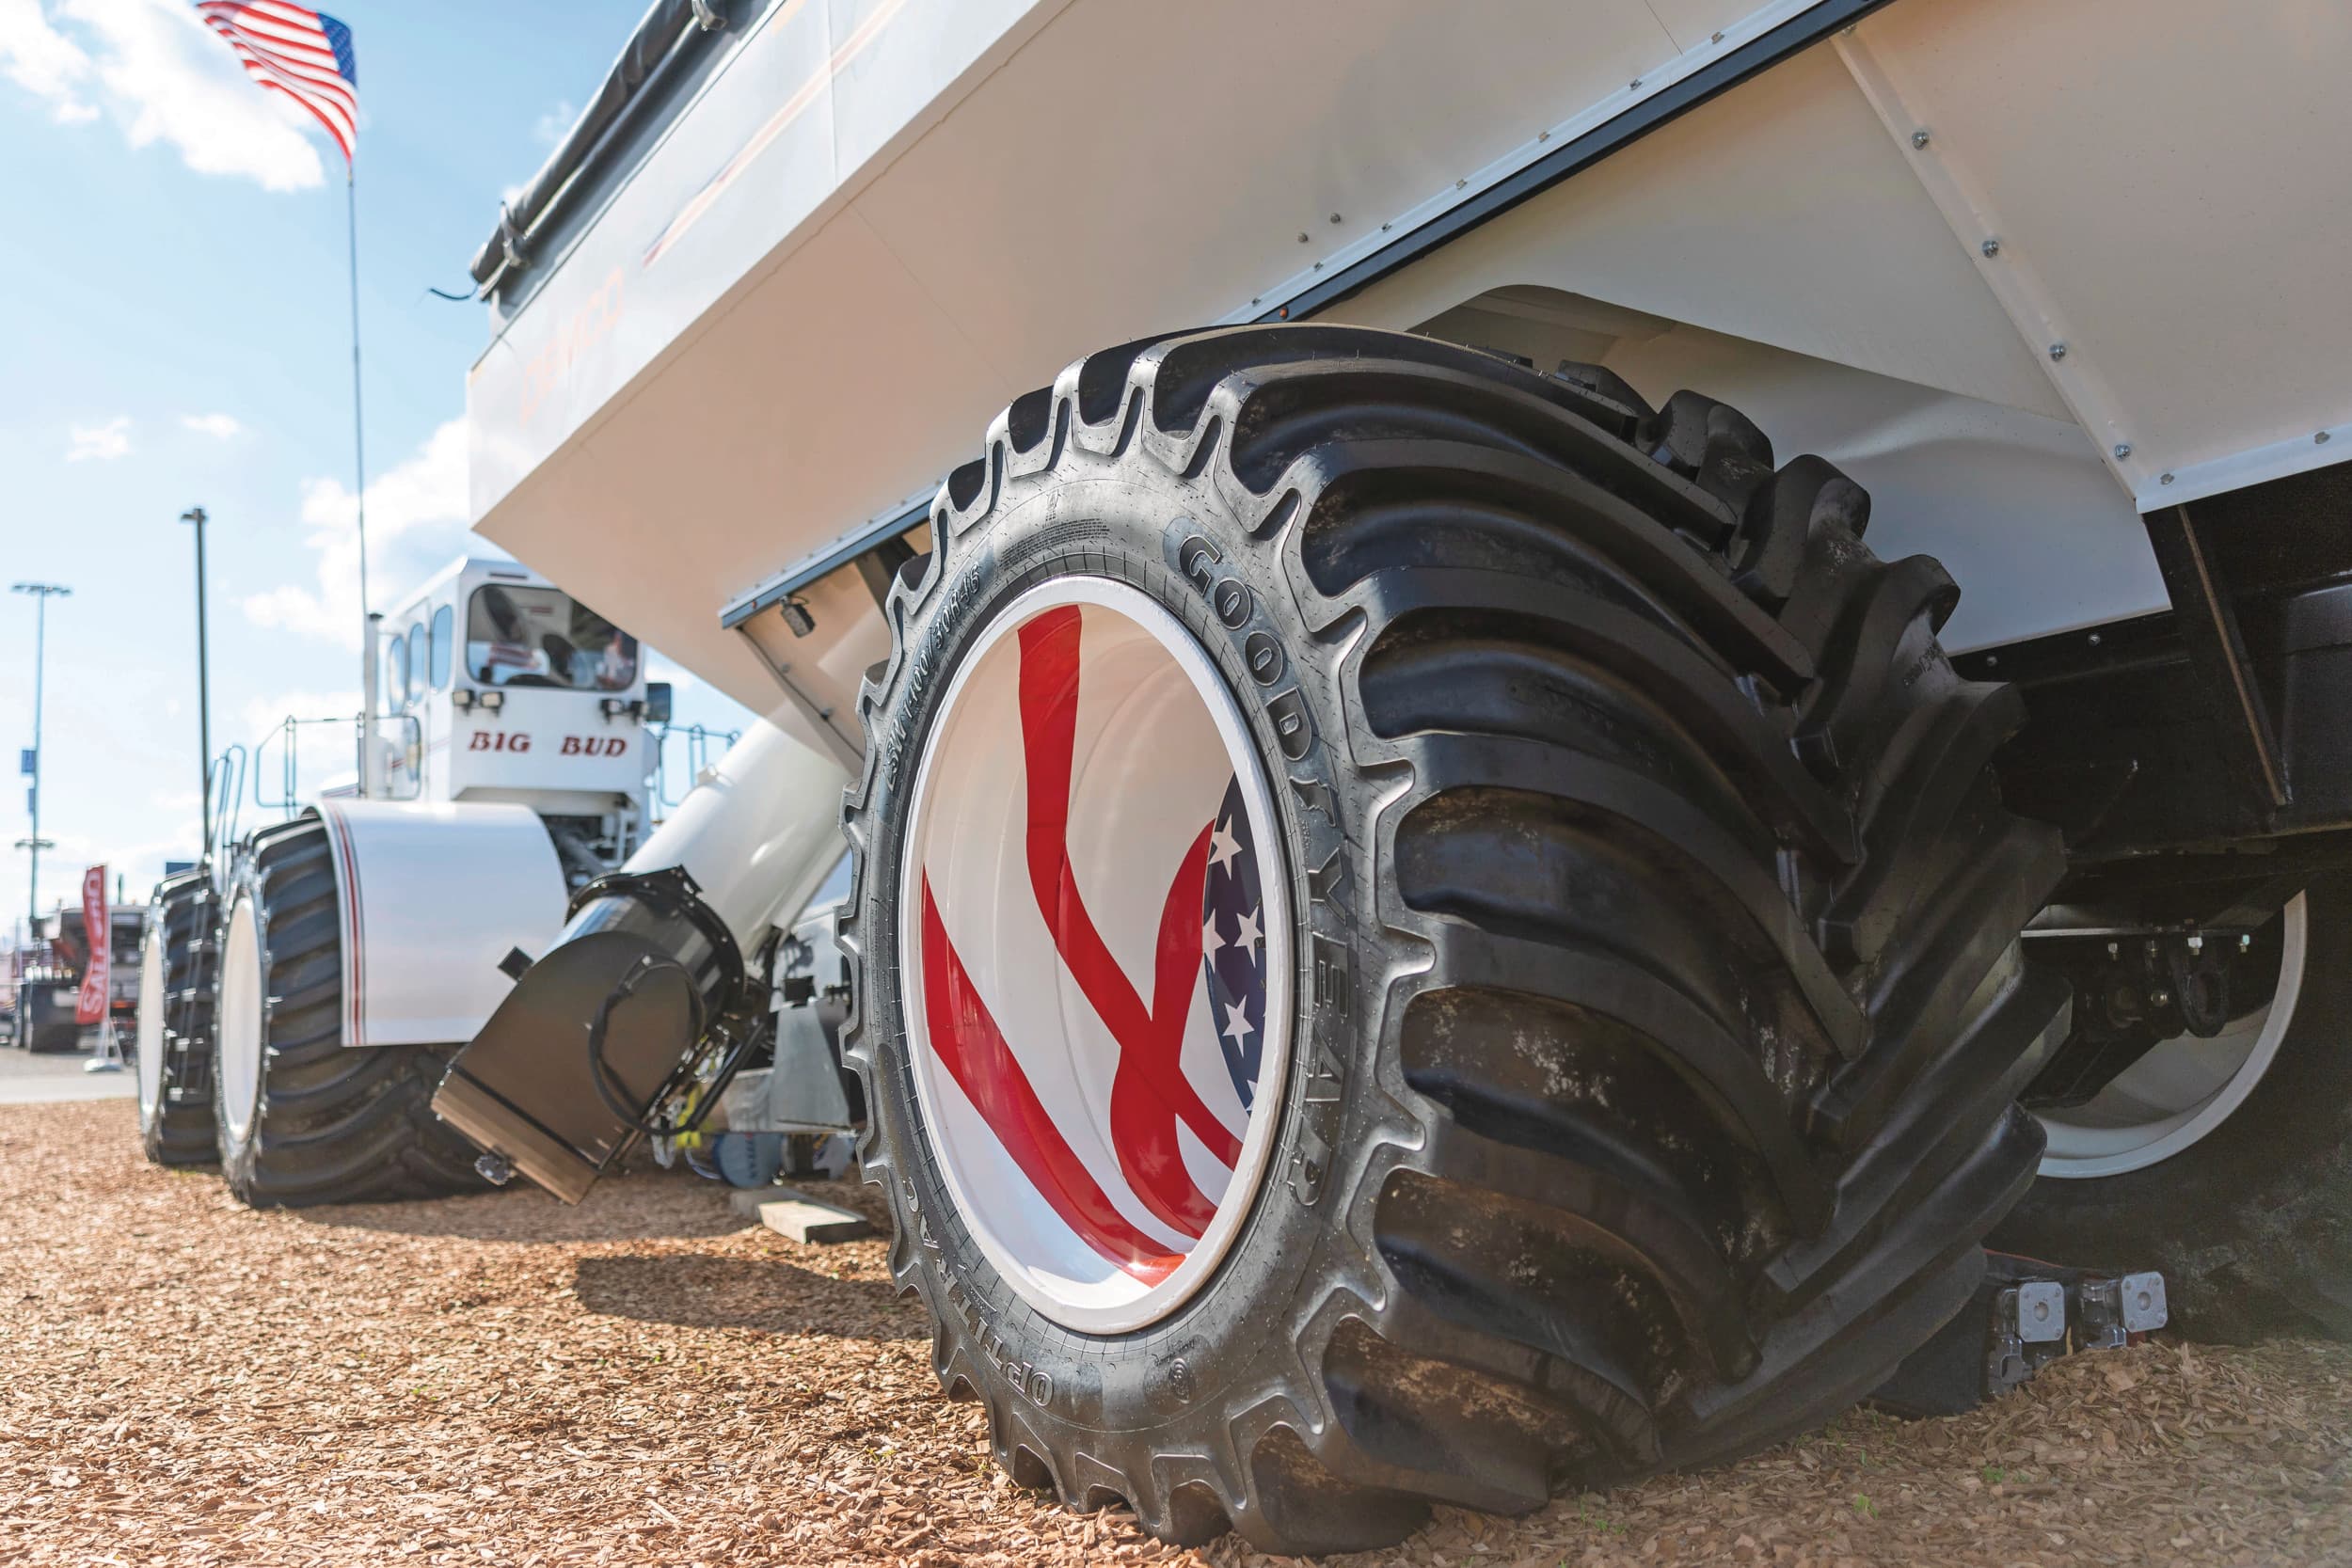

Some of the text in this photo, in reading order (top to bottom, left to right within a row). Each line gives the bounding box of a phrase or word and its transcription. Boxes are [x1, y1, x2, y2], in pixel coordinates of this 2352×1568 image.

[469, 731, 628, 757] BIG BUD
[902, 1177, 1055, 1407] OPTITRAC
